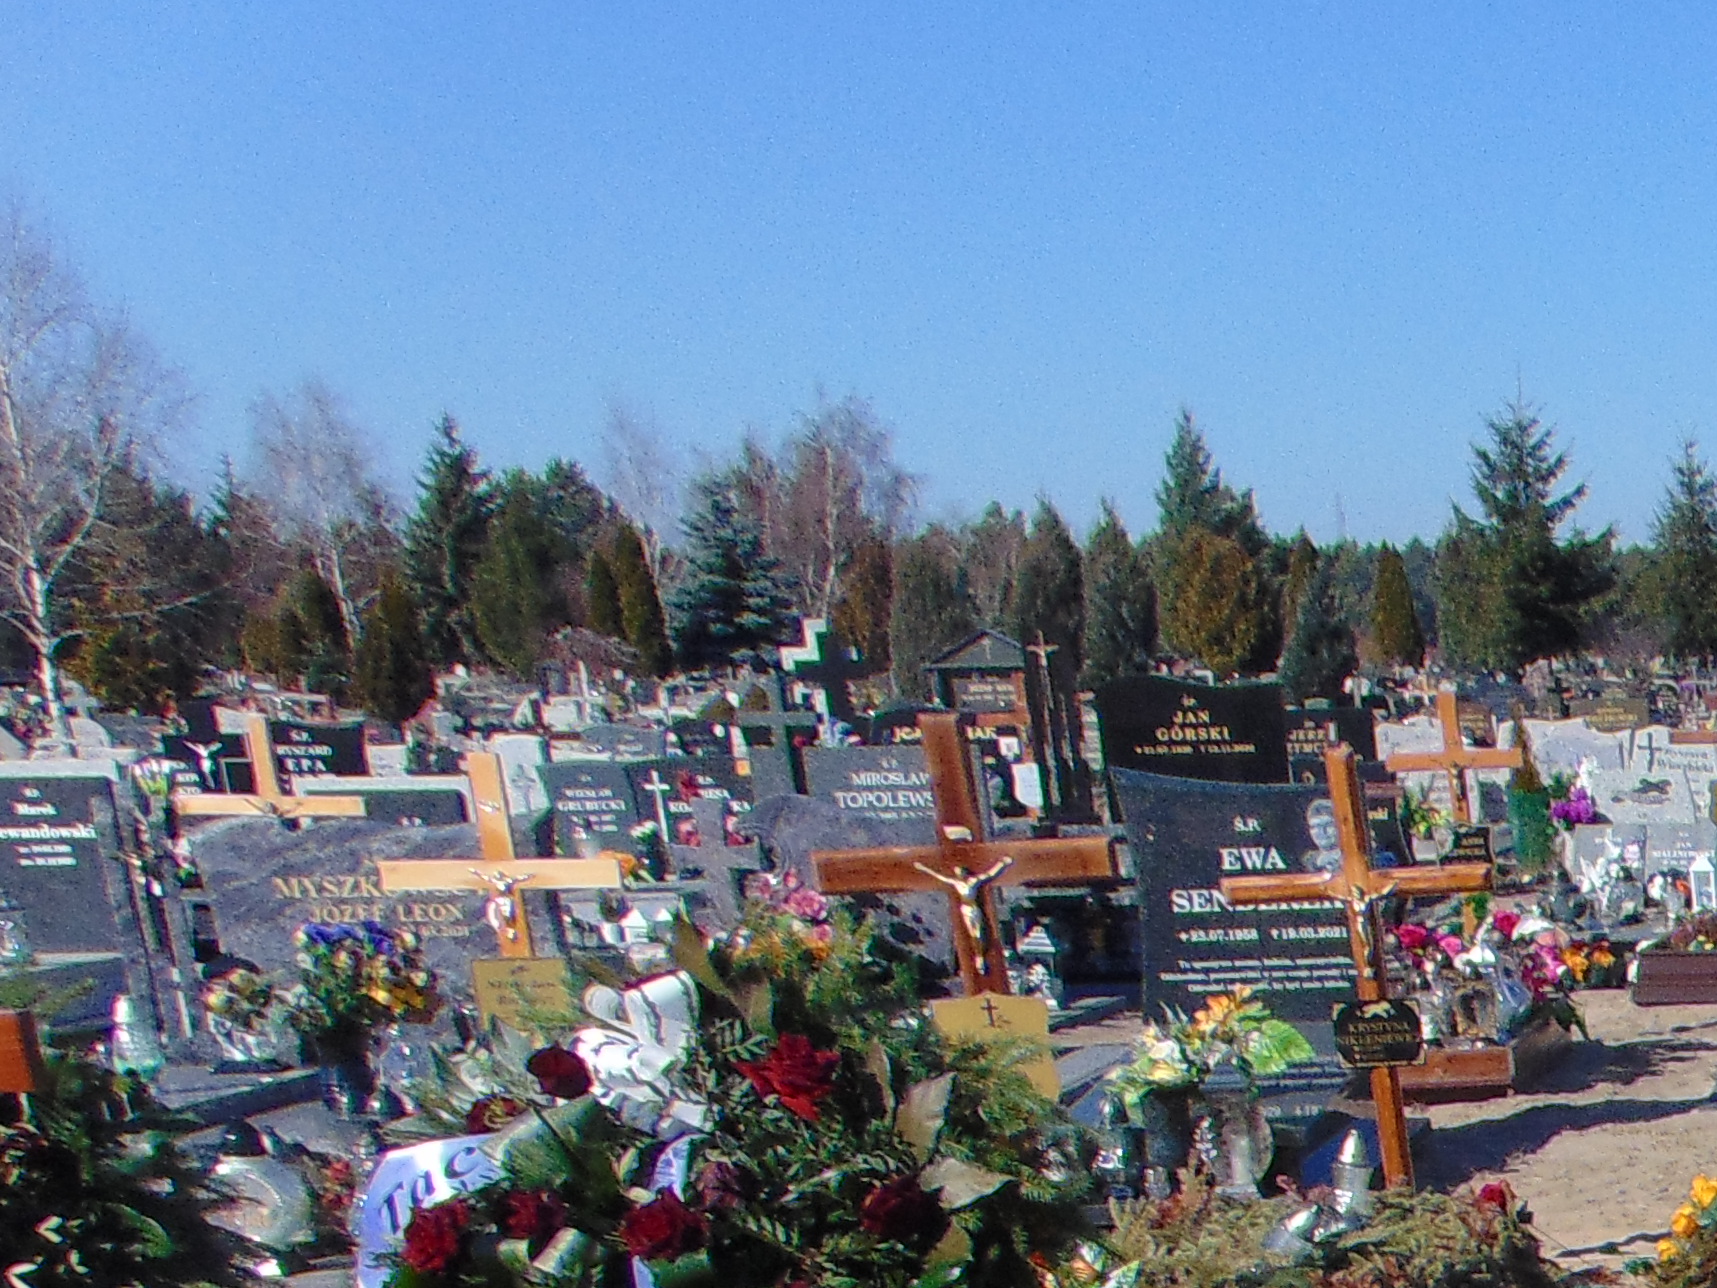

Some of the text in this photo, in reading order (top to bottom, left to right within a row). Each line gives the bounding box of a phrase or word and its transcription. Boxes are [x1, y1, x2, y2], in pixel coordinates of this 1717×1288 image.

[1172, 709, 1210, 723] JAN
[1155, 724, 1231, 741] GÓRSKI
[1220, 847, 1287, 871] EWA
